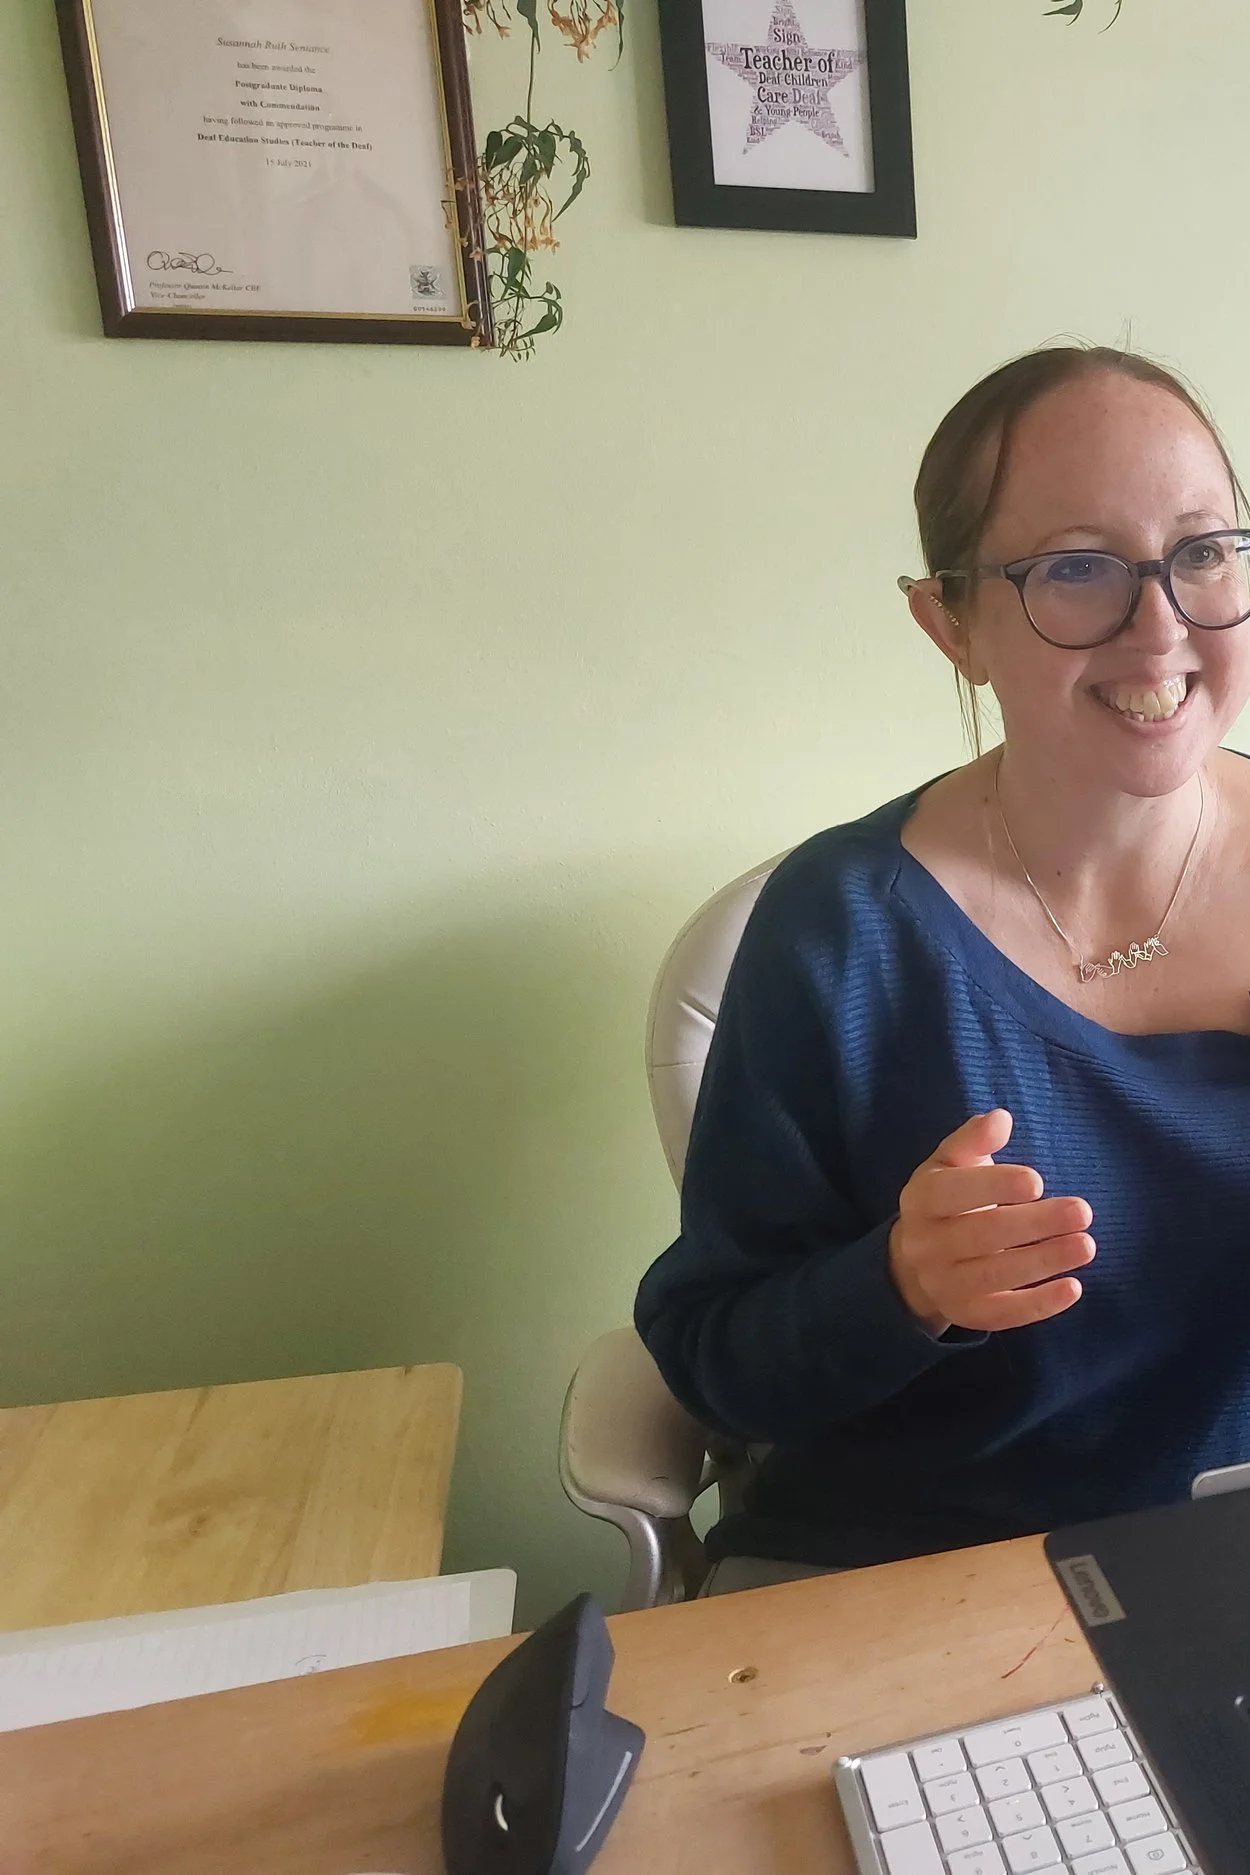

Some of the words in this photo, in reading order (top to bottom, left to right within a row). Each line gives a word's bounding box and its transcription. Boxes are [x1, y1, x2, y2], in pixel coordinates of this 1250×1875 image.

[217, 37, 262, 49] Susannah
[264, 40, 287, 50] Ruth
[773, 28, 801, 45] Sign
[740, 47, 812, 72] Teacher
[818, 52, 835, 73] of
[251, 62, 269, 71] been
[304, 66, 316, 74] the
[235, 80, 287, 91] Postgraduate
[289, 83, 323, 93] Diploma
[758, 72, 781, 85] Deaf
[784, 73, 828, 87] Children
[757, 86, 788, 104] Care
[791, 88, 821, 105] Deaf
[240, 100, 258, 108] with
[260, 101, 320, 111] Commendation
[765, 105, 791, 118] Young
[793, 106, 820, 119] People
[203, 115, 228, 126] having
[230, 117, 264, 127] followed
[276, 121, 311, 130] approved
[312, 124, 353, 132] programme
[750, 126, 767, 136] BSL
[197, 133, 217, 141] Deaf
[218, 134, 259, 144] Education
[261, 137, 290, 146] Studies
[291, 138, 325, 148] (Teacher
[337, 141, 350, 149] the
[351, 143, 373, 151] Deaf)
[276, 158, 292, 168] July
[1069, 1561, 1110, 1618] Lenovo
